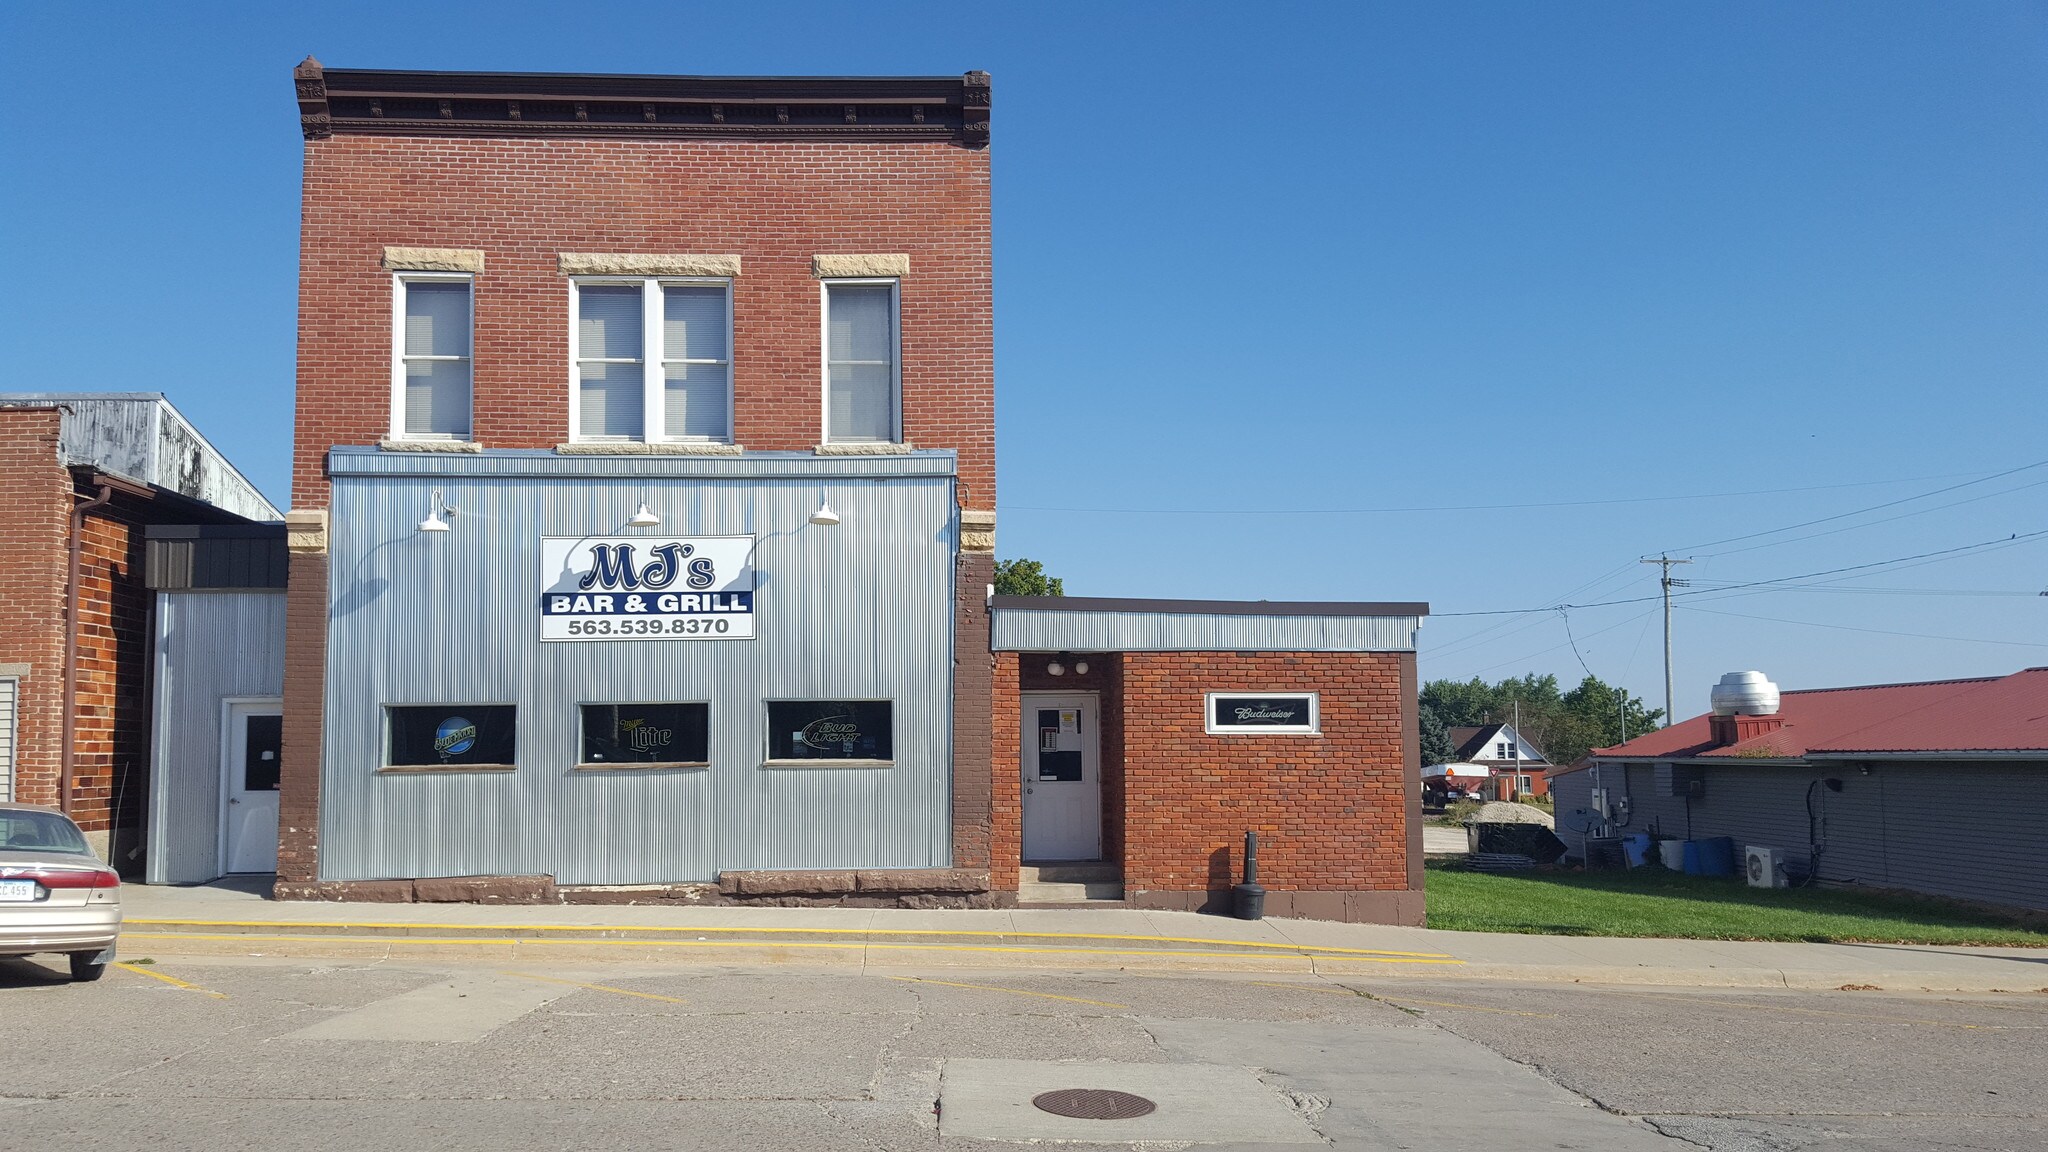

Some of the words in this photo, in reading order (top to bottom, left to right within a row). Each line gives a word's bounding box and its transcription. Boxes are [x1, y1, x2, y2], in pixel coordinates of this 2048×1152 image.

[578, 542, 716, 591] MJ's
[551, 595, 615, 613] BAR
[624, 594, 648, 613] &
[657, 594, 748, 612] GRILL
[568, 618, 730, 635] 563.539.8370
[1235, 707, 1295, 720] Budweiser
[819, 723, 857, 732] BUD
[630, 727, 672, 752] Lite
[810, 732, 862, 742] LIGHT
